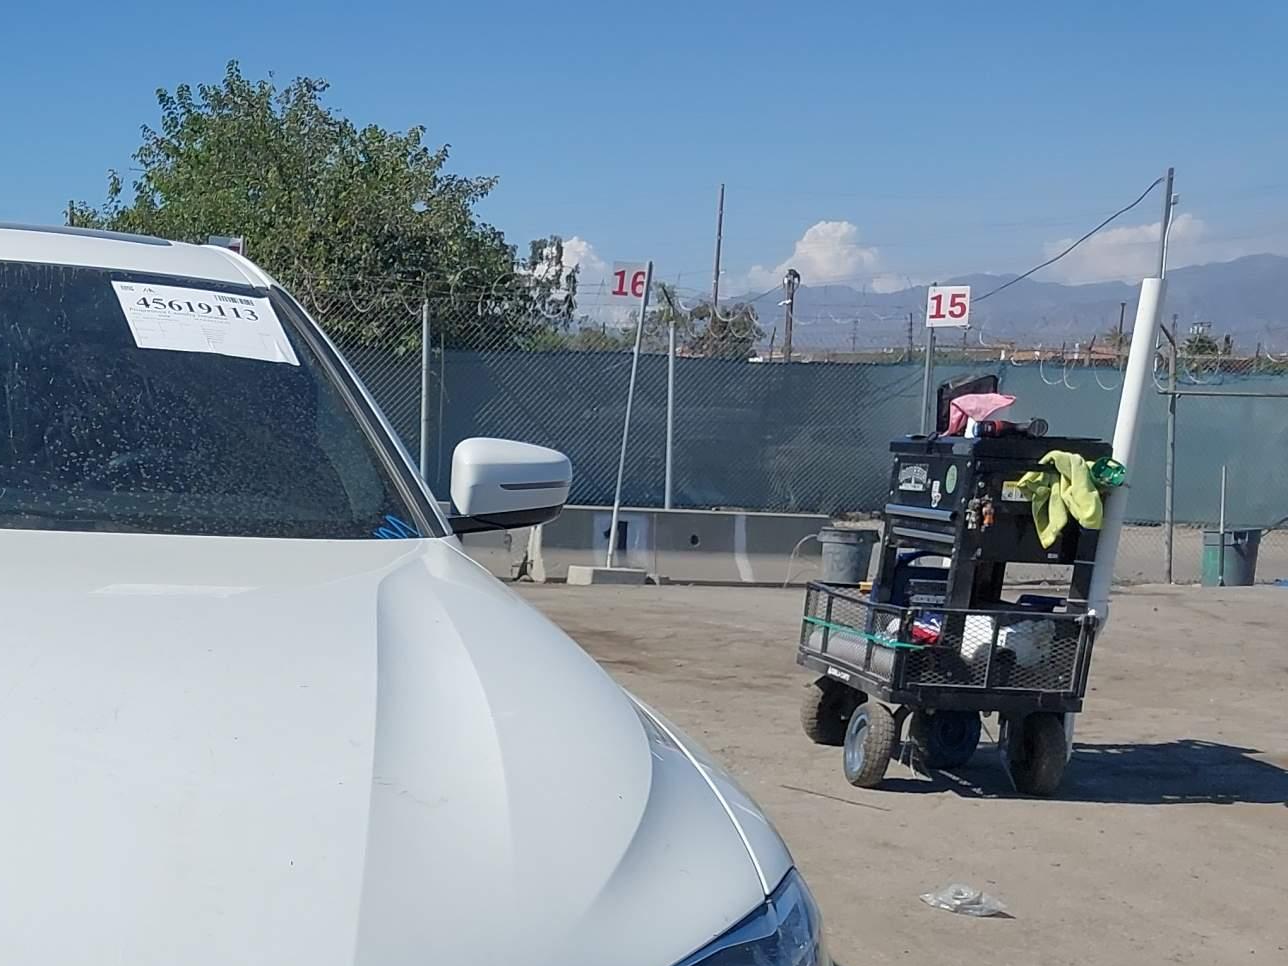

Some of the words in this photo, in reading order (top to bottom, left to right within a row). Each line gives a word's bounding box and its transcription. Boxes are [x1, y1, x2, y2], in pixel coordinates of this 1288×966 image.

[612, 270, 646, 298] 16
[136, 296, 259, 322] 45619113
[929, 293, 967, 319] 15
